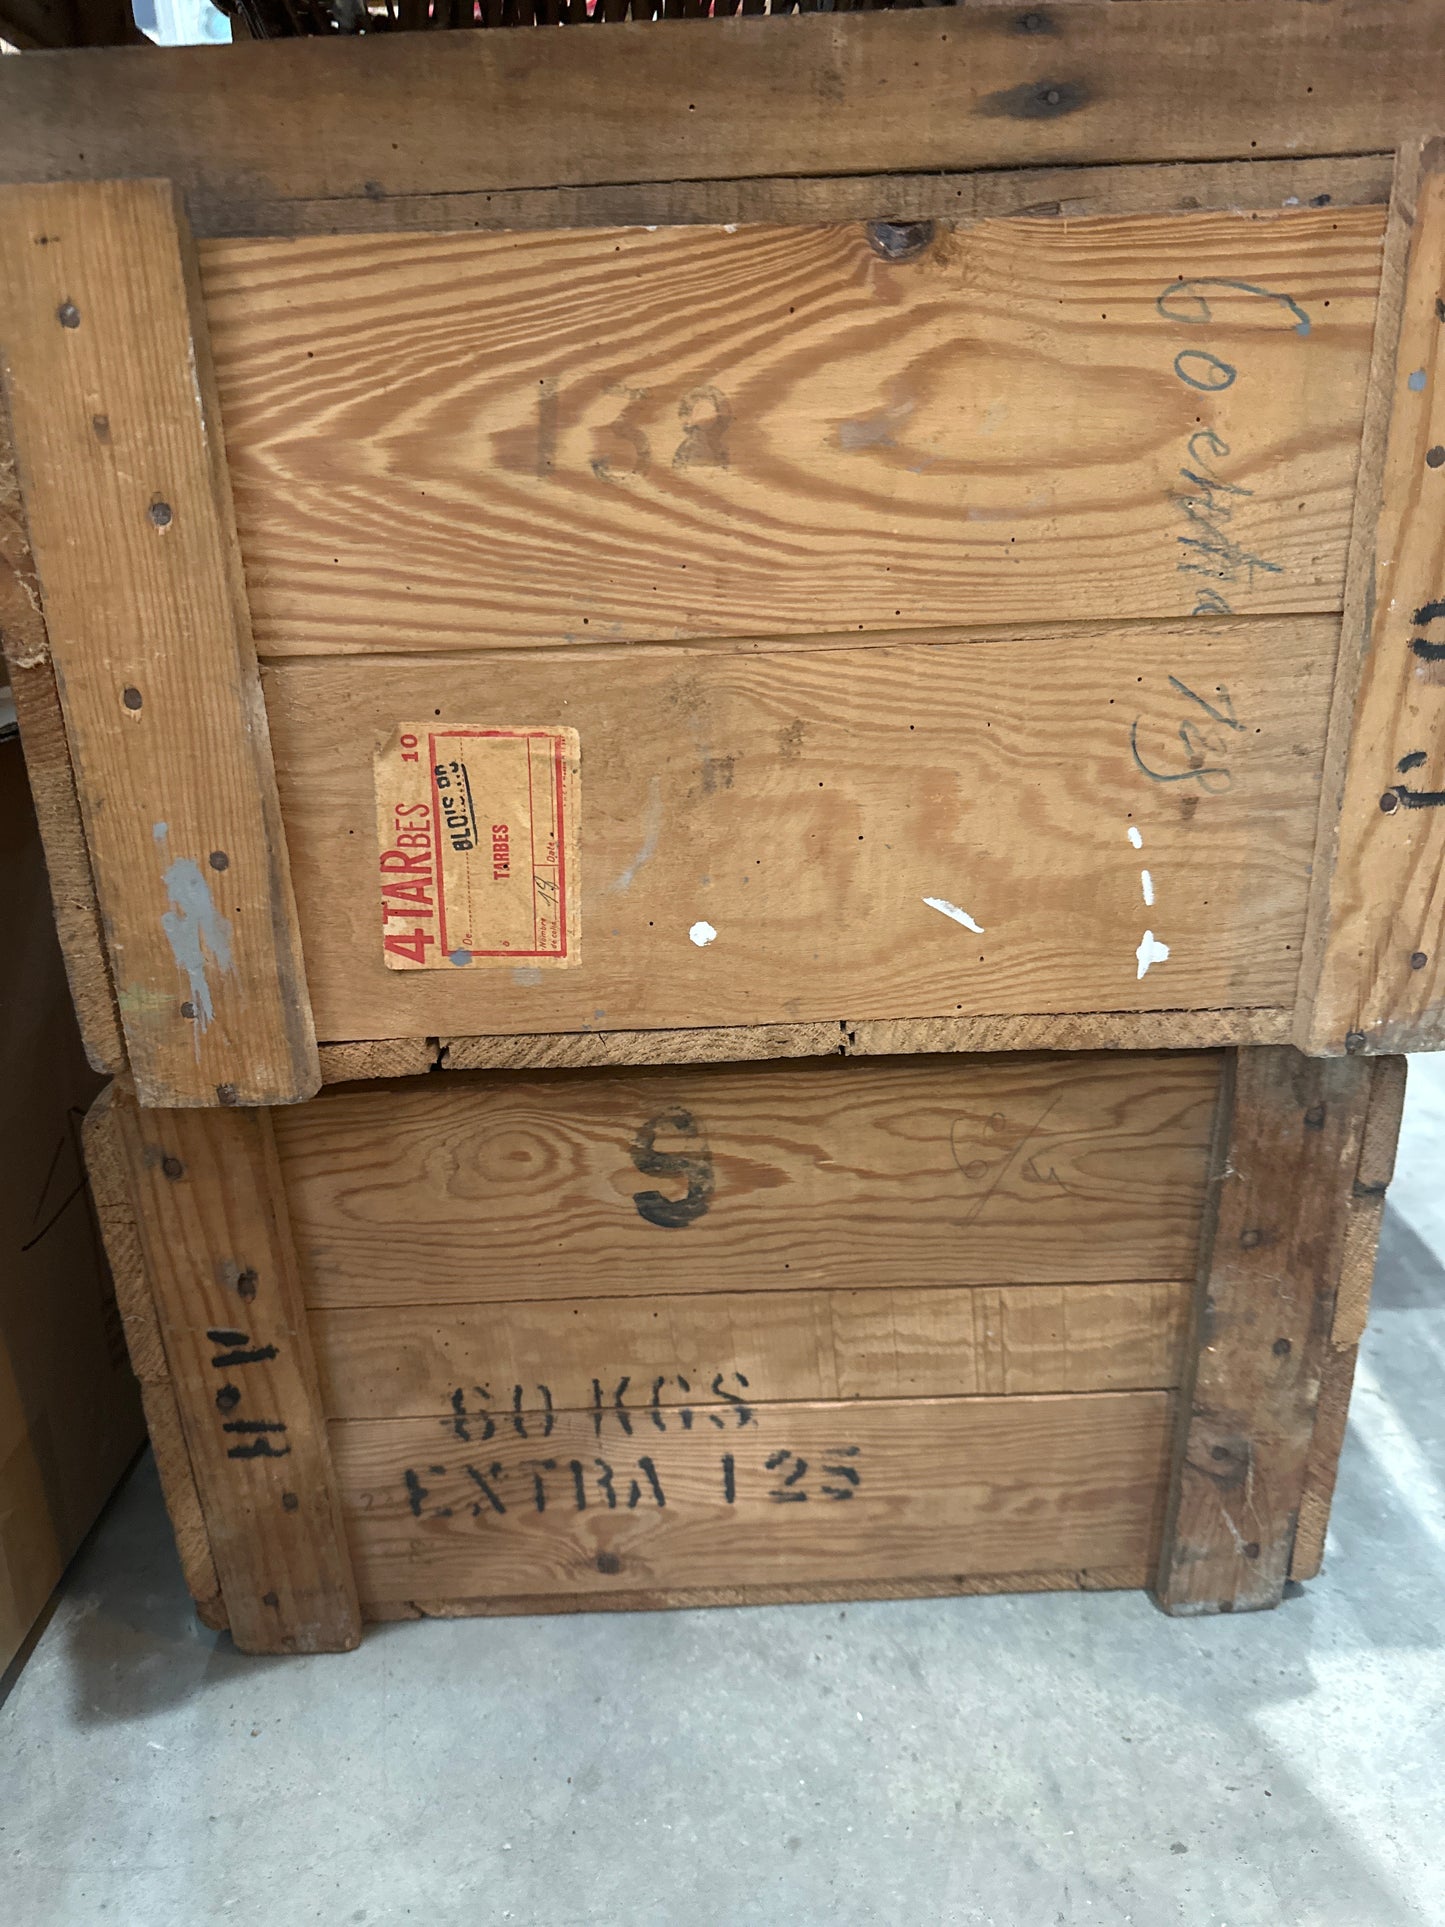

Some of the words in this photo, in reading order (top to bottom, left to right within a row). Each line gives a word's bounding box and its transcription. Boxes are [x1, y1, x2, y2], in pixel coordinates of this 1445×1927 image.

[401, 734, 419, 763] 10
[492, 824, 510, 881] TARBES
[546, 842, 557, 863] Date
[631, 1105, 716, 1229] S
[592, 1372, 758, 1439] KGS
[404, 1456, 667, 1518] EXTRA
[721, 1446, 862, 1504] 125
